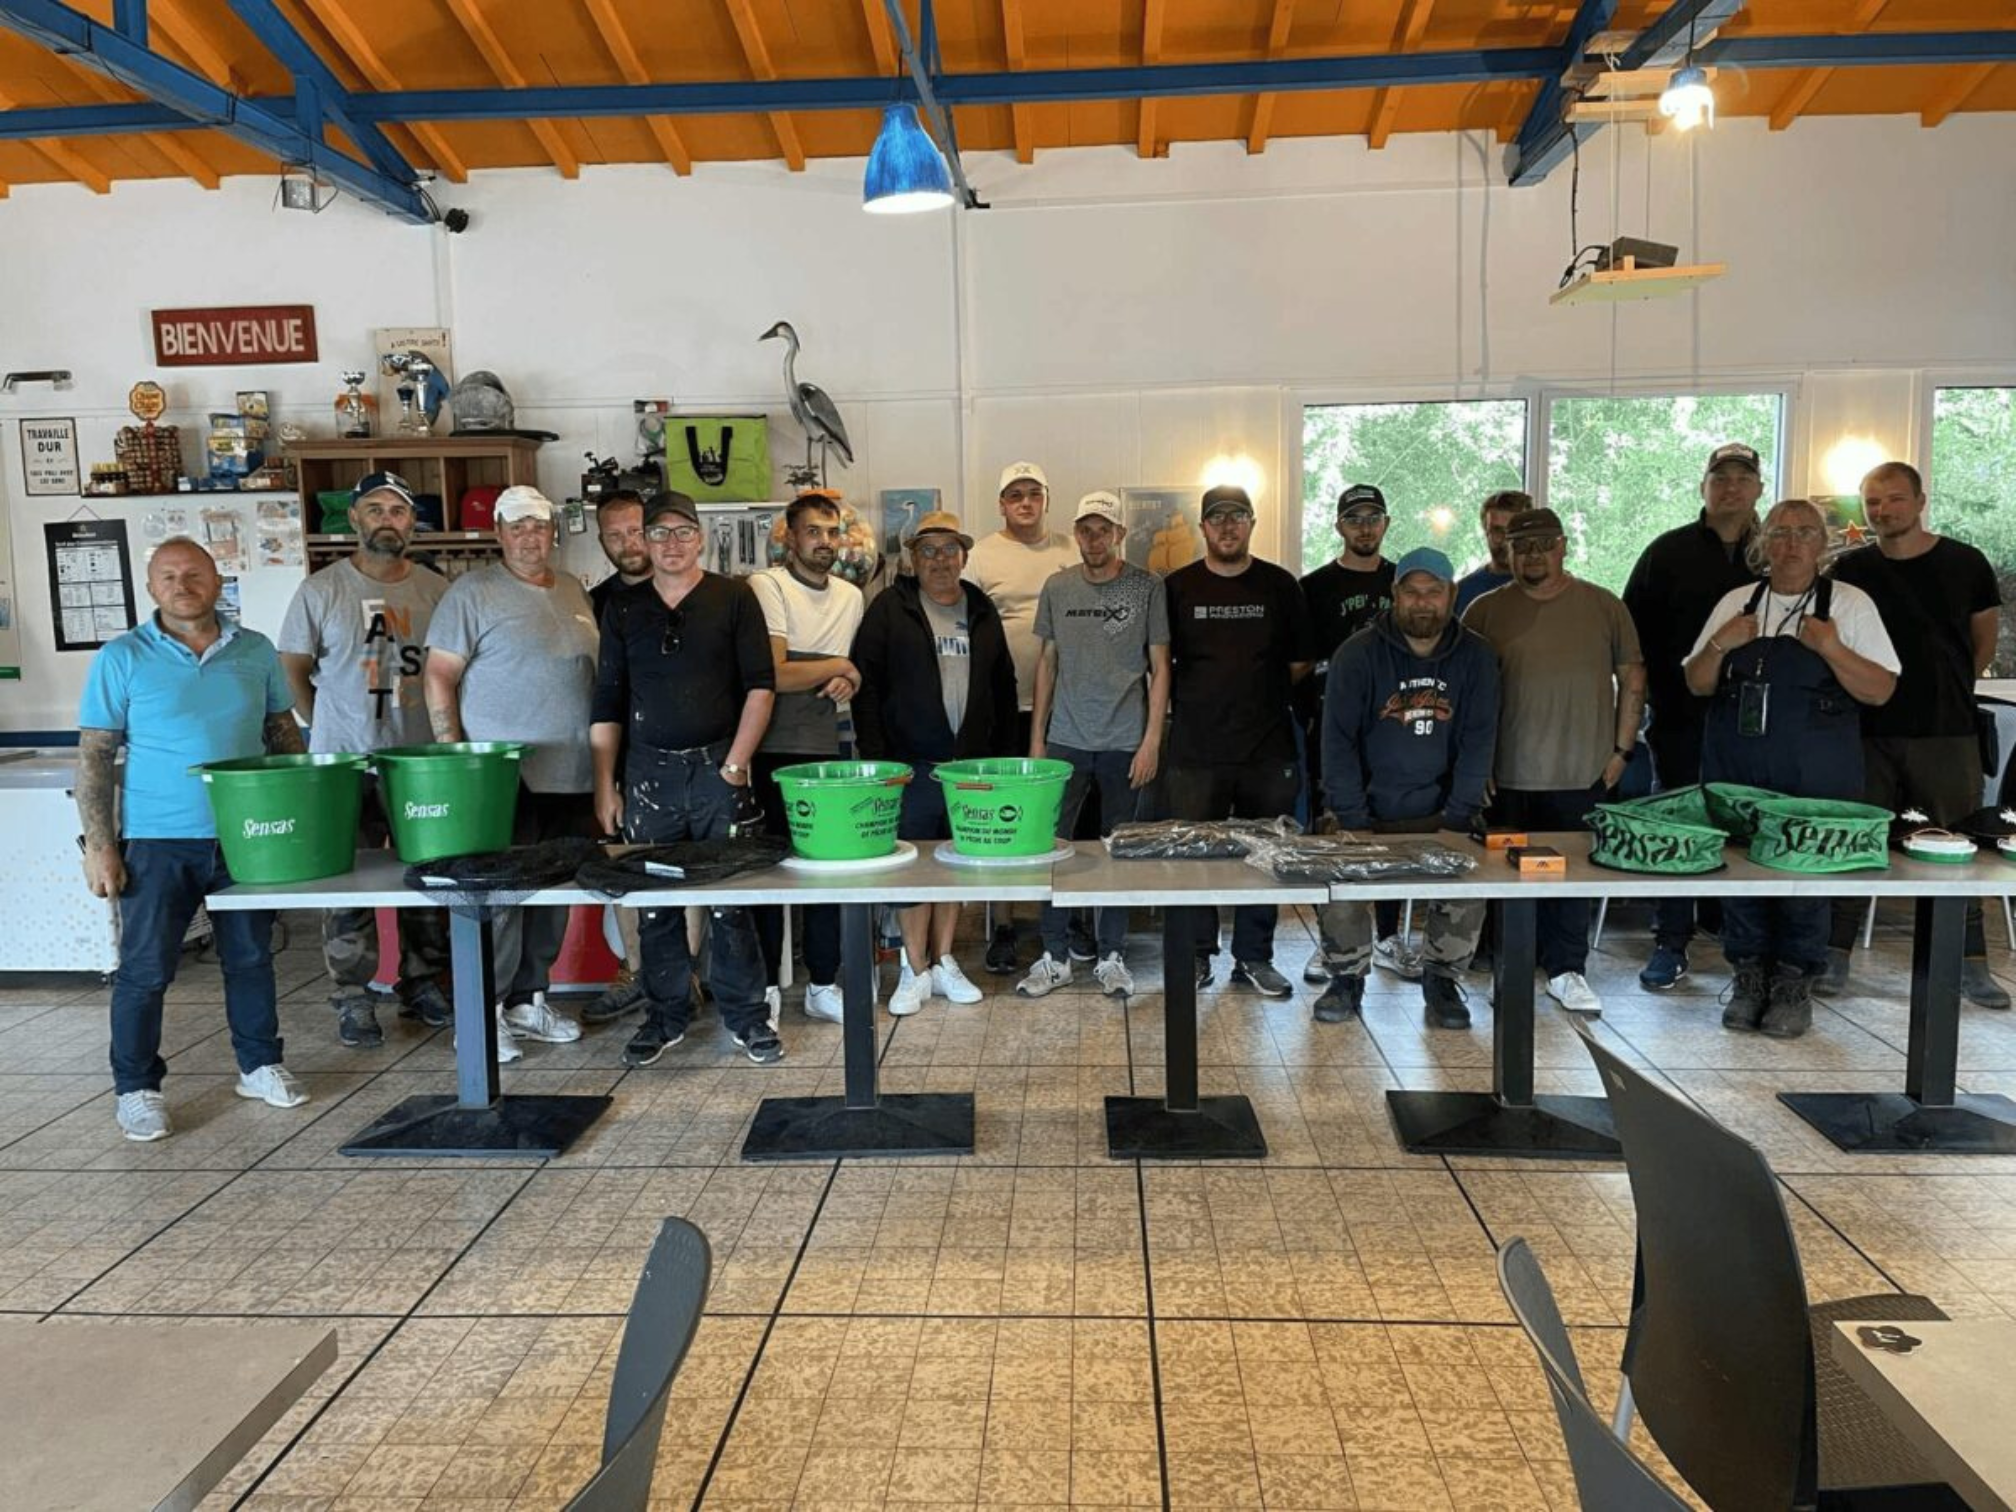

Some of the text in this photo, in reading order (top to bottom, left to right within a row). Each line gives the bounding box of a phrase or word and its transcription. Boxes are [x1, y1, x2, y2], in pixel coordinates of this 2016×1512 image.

[160, 318, 305, 356] BIENVENUE
[27, 428, 70, 440] TRAVAILLE
[38, 441, 62, 453] DUR
[1209, 605, 1264, 614] PRESTON
[1414, 720, 1434, 735] 90
[404, 801, 449, 820] Sensas
[242, 818, 296, 839] Sensas
